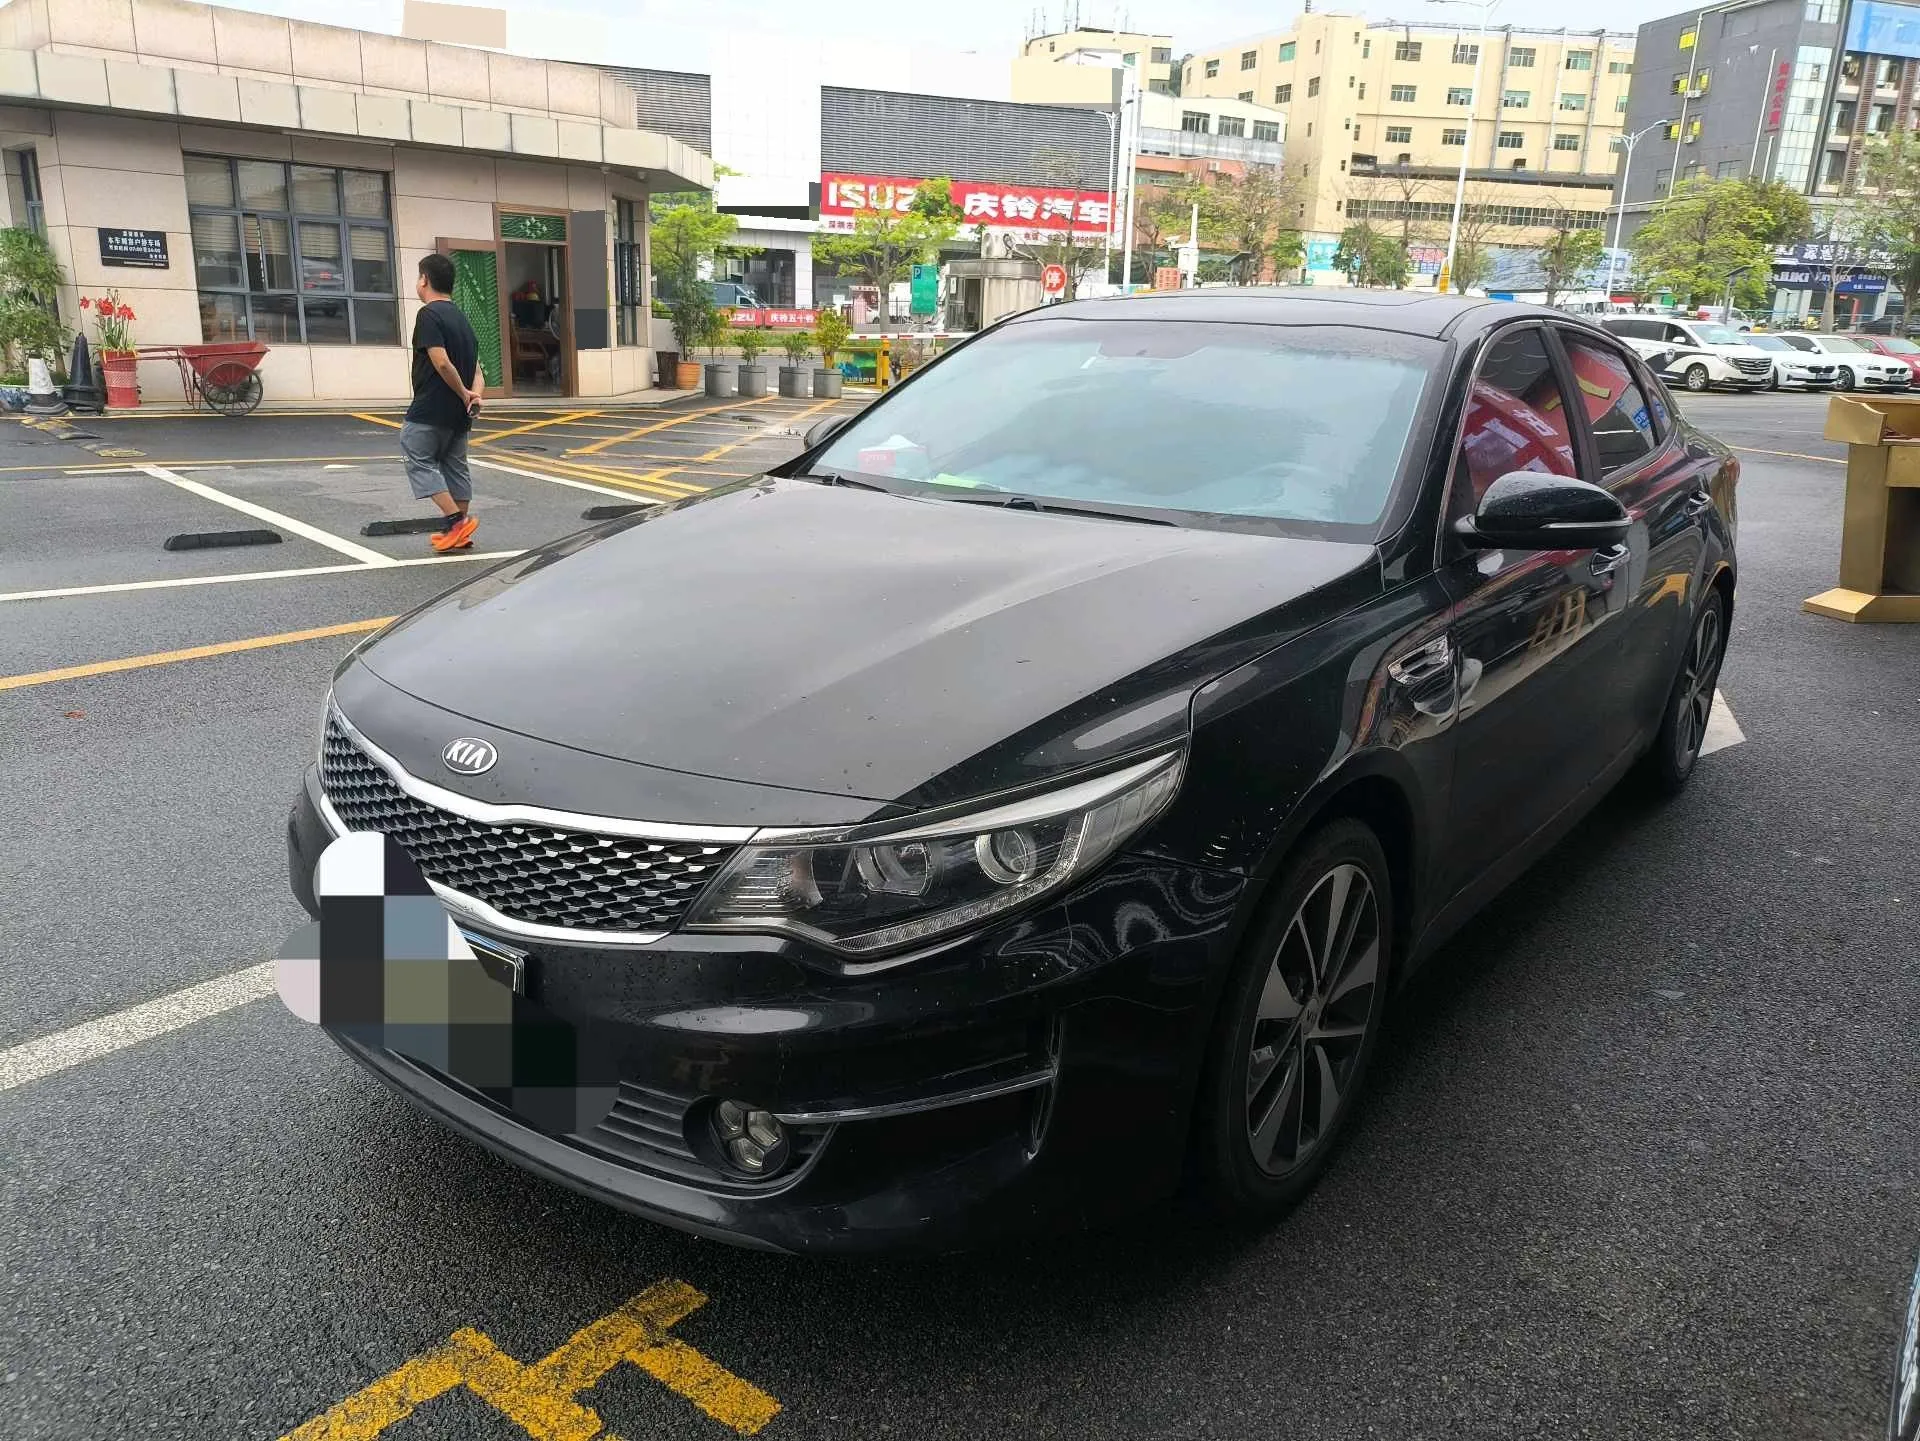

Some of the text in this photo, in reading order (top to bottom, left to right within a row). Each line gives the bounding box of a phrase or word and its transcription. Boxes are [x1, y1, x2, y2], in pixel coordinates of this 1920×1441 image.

[828, 181, 916, 211] ISUZ
[963, 192, 1109, 224] 庆铃汽车
[1046, 270, 1061, 288] 停
[445, 741, 488, 769] KIA
